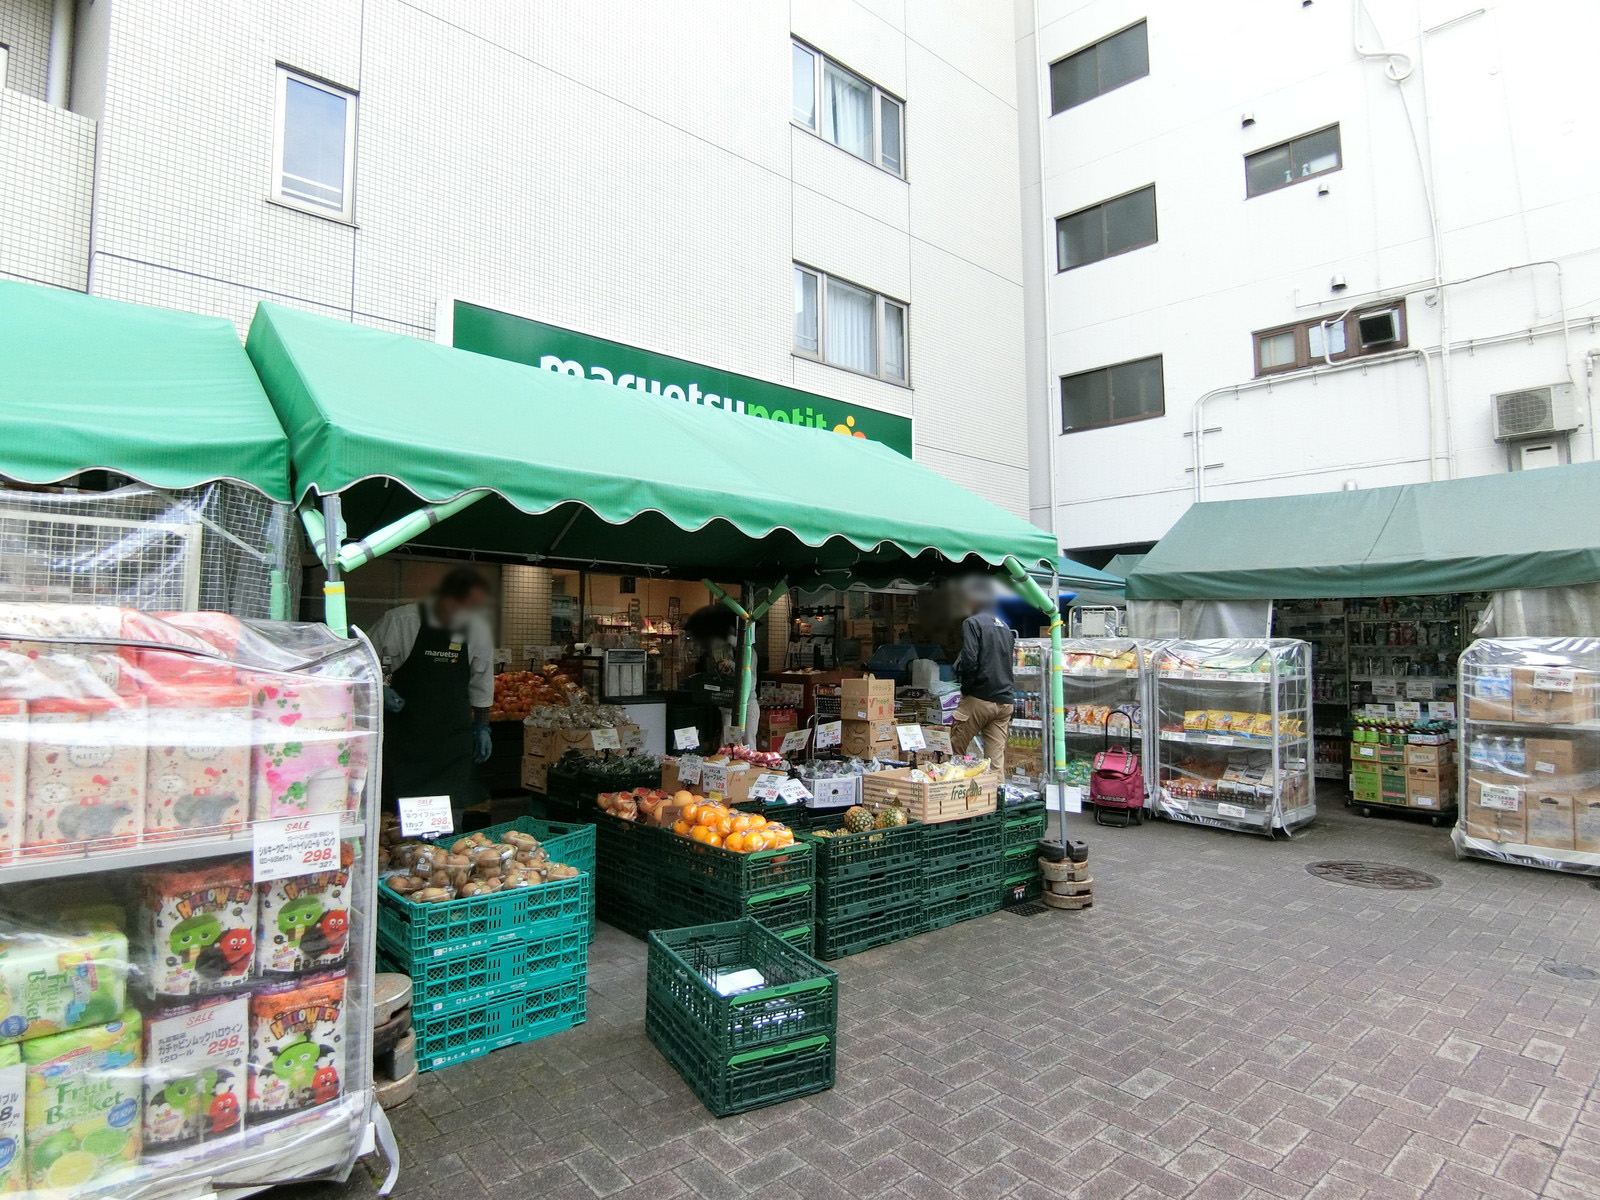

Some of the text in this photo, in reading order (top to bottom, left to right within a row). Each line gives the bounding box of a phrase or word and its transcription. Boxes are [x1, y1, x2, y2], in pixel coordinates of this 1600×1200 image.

[425, 650, 459, 658] maruetsu
[76, 753, 106, 761] KITTY
[951, 785, 983, 801] frescana
[284, 821, 310, 832] SALE
[187, 1011, 215, 1026] SALE
[160, 1049, 195, 1063] 12ロール
[55, 1076, 114, 1104] Fruit
[45, 1089, 126, 1125] Basket
